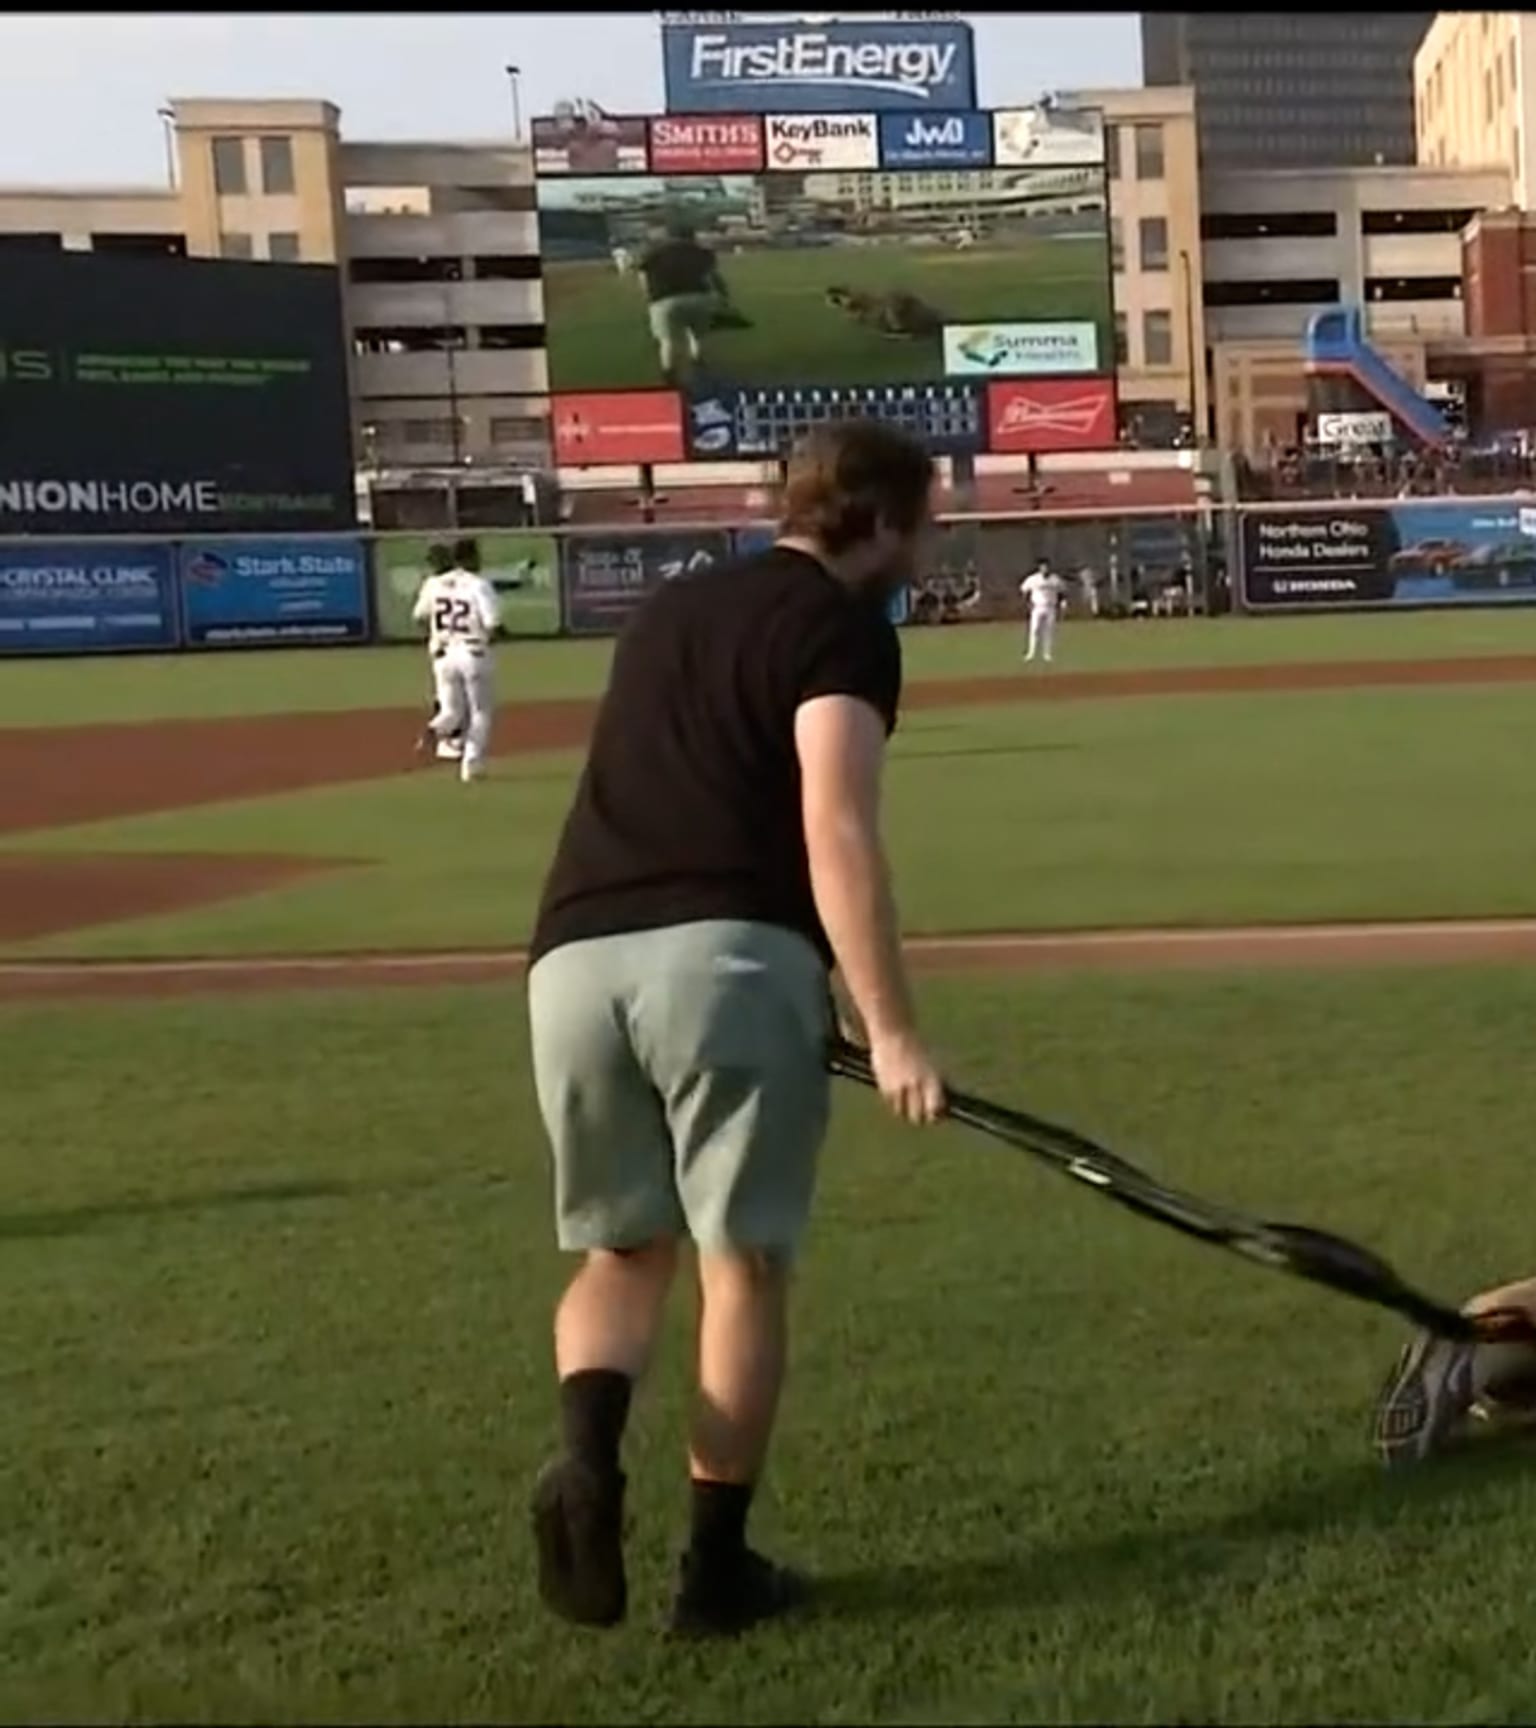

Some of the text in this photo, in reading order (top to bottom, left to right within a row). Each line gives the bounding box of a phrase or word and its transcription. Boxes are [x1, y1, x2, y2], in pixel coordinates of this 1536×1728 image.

[690, 33, 956, 84] FirstEnergy
[771, 120, 871, 141] KeyBank
[435, 597, 471, 632] 22
